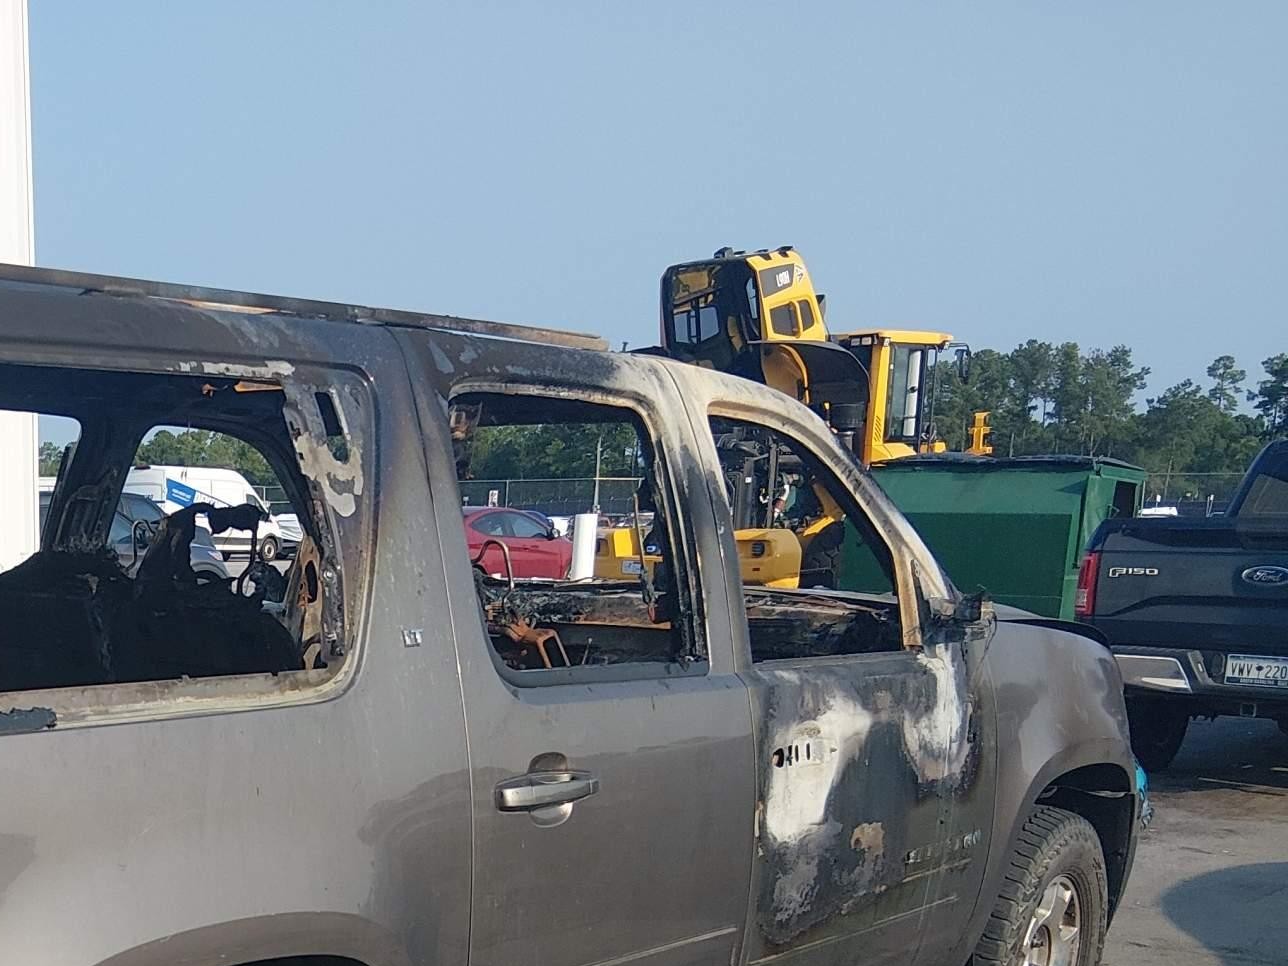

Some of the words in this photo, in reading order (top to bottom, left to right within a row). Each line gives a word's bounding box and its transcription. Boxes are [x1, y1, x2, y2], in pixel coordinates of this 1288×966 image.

[1253, 569, 1282, 583] Ford
[1231, 662, 1253, 677] VWV
[1264, 664, 1288, 680] 220
